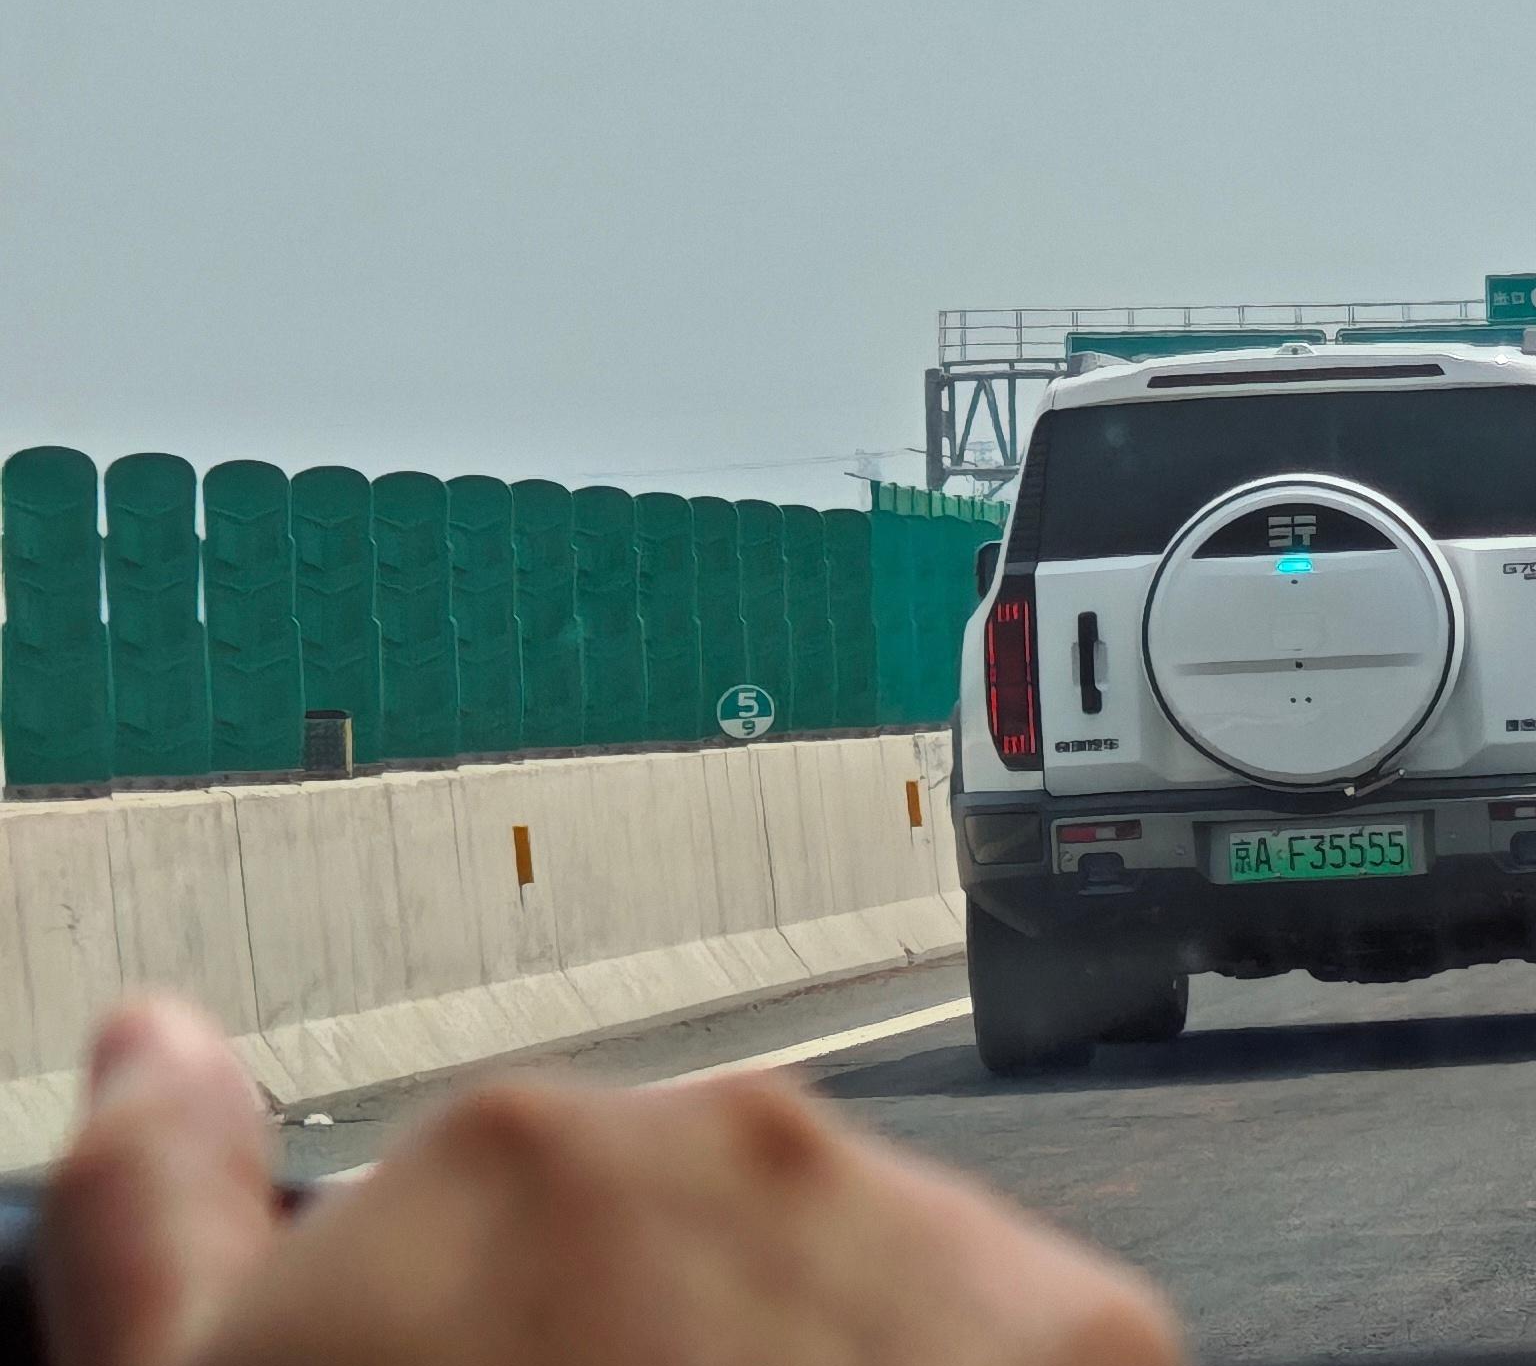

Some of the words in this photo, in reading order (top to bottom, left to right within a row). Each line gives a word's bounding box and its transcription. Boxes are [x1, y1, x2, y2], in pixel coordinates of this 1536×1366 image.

[738, 691, 759, 718] 5
[742, 720, 756, 736] 9
[1288, 831, 1405, 872] F35555
